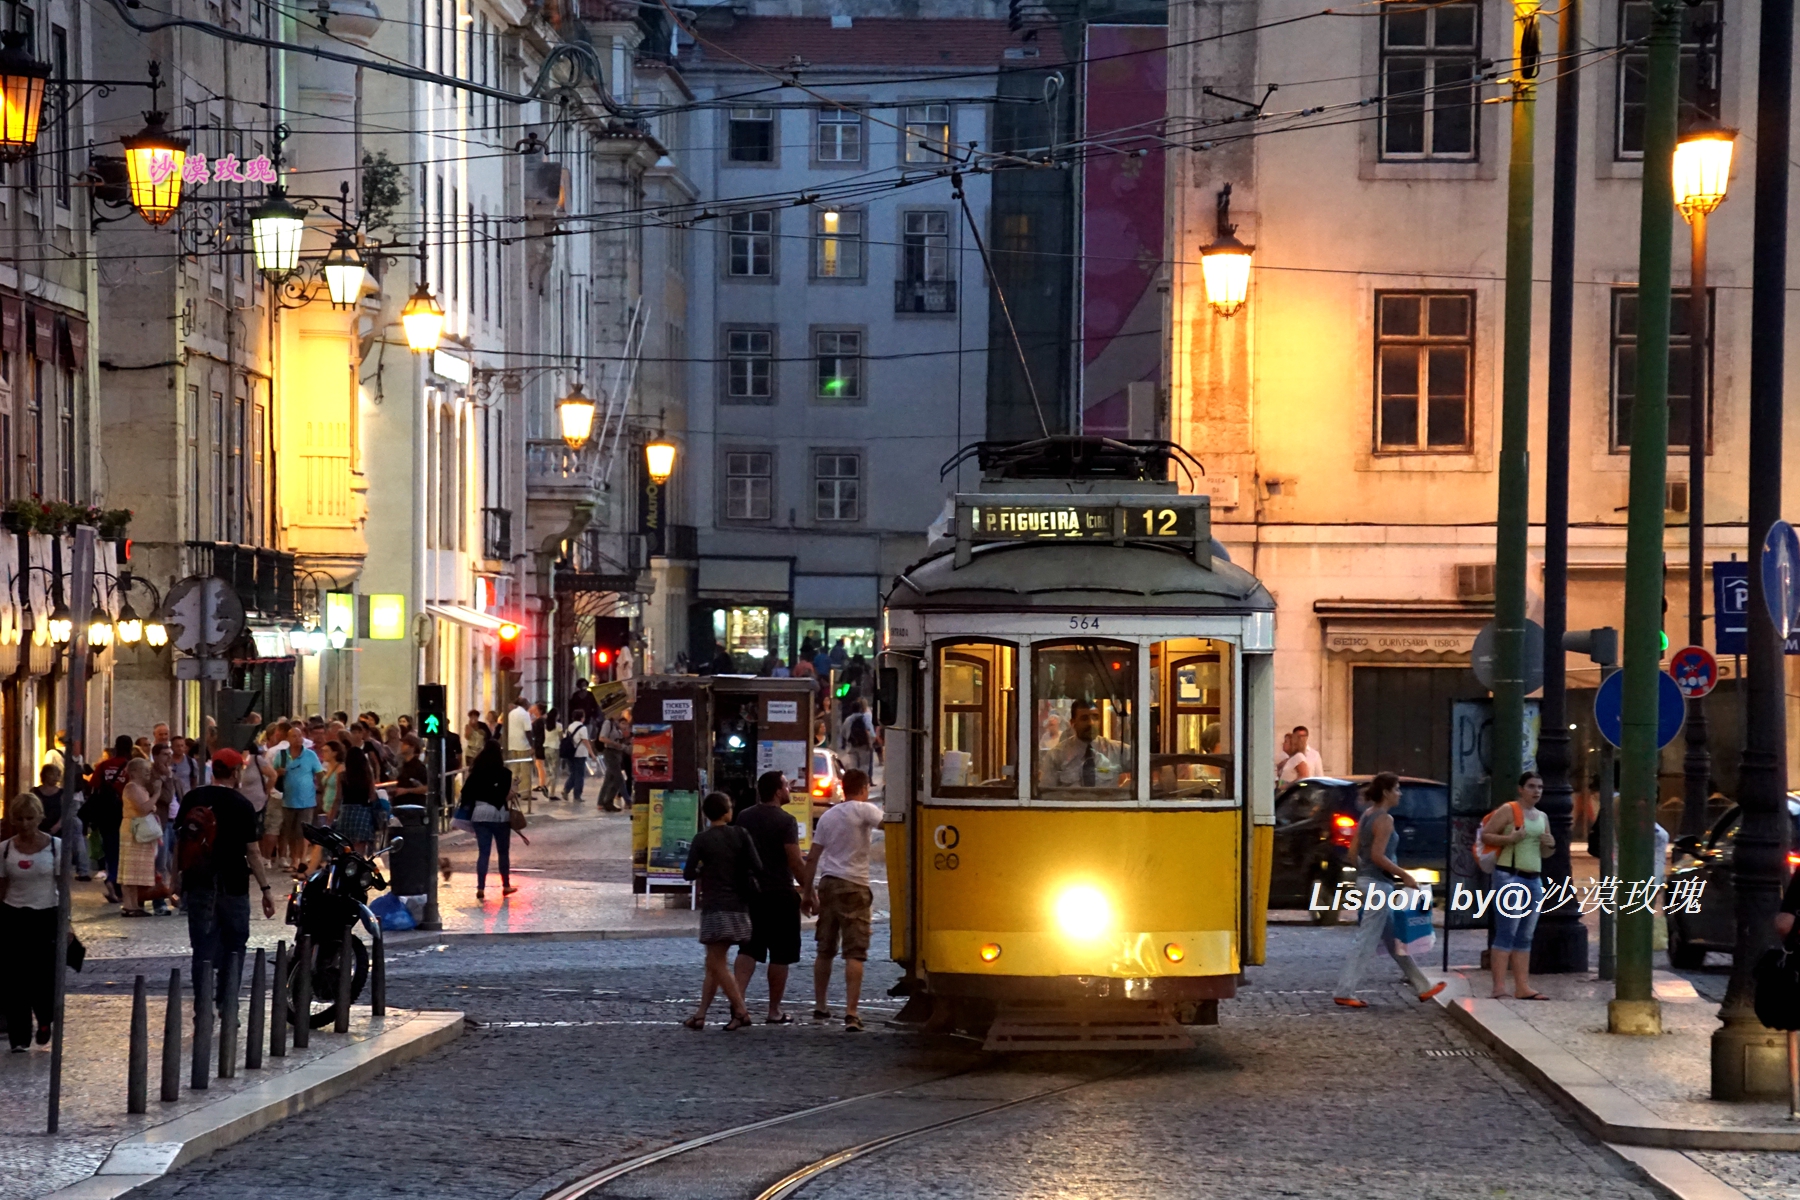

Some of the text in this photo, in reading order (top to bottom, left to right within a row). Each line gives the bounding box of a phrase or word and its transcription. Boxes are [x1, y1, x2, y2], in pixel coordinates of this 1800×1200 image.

[986, 513, 997, 531] P.
[1001, 510, 1080, 531] FIGUEIRA
[1142, 509, 1178, 536] 12
[1069, 616, 1100, 630] 564
[1333, 637, 1369, 646] SEIKO
[1434, 639, 1461, 647] LISBOA
